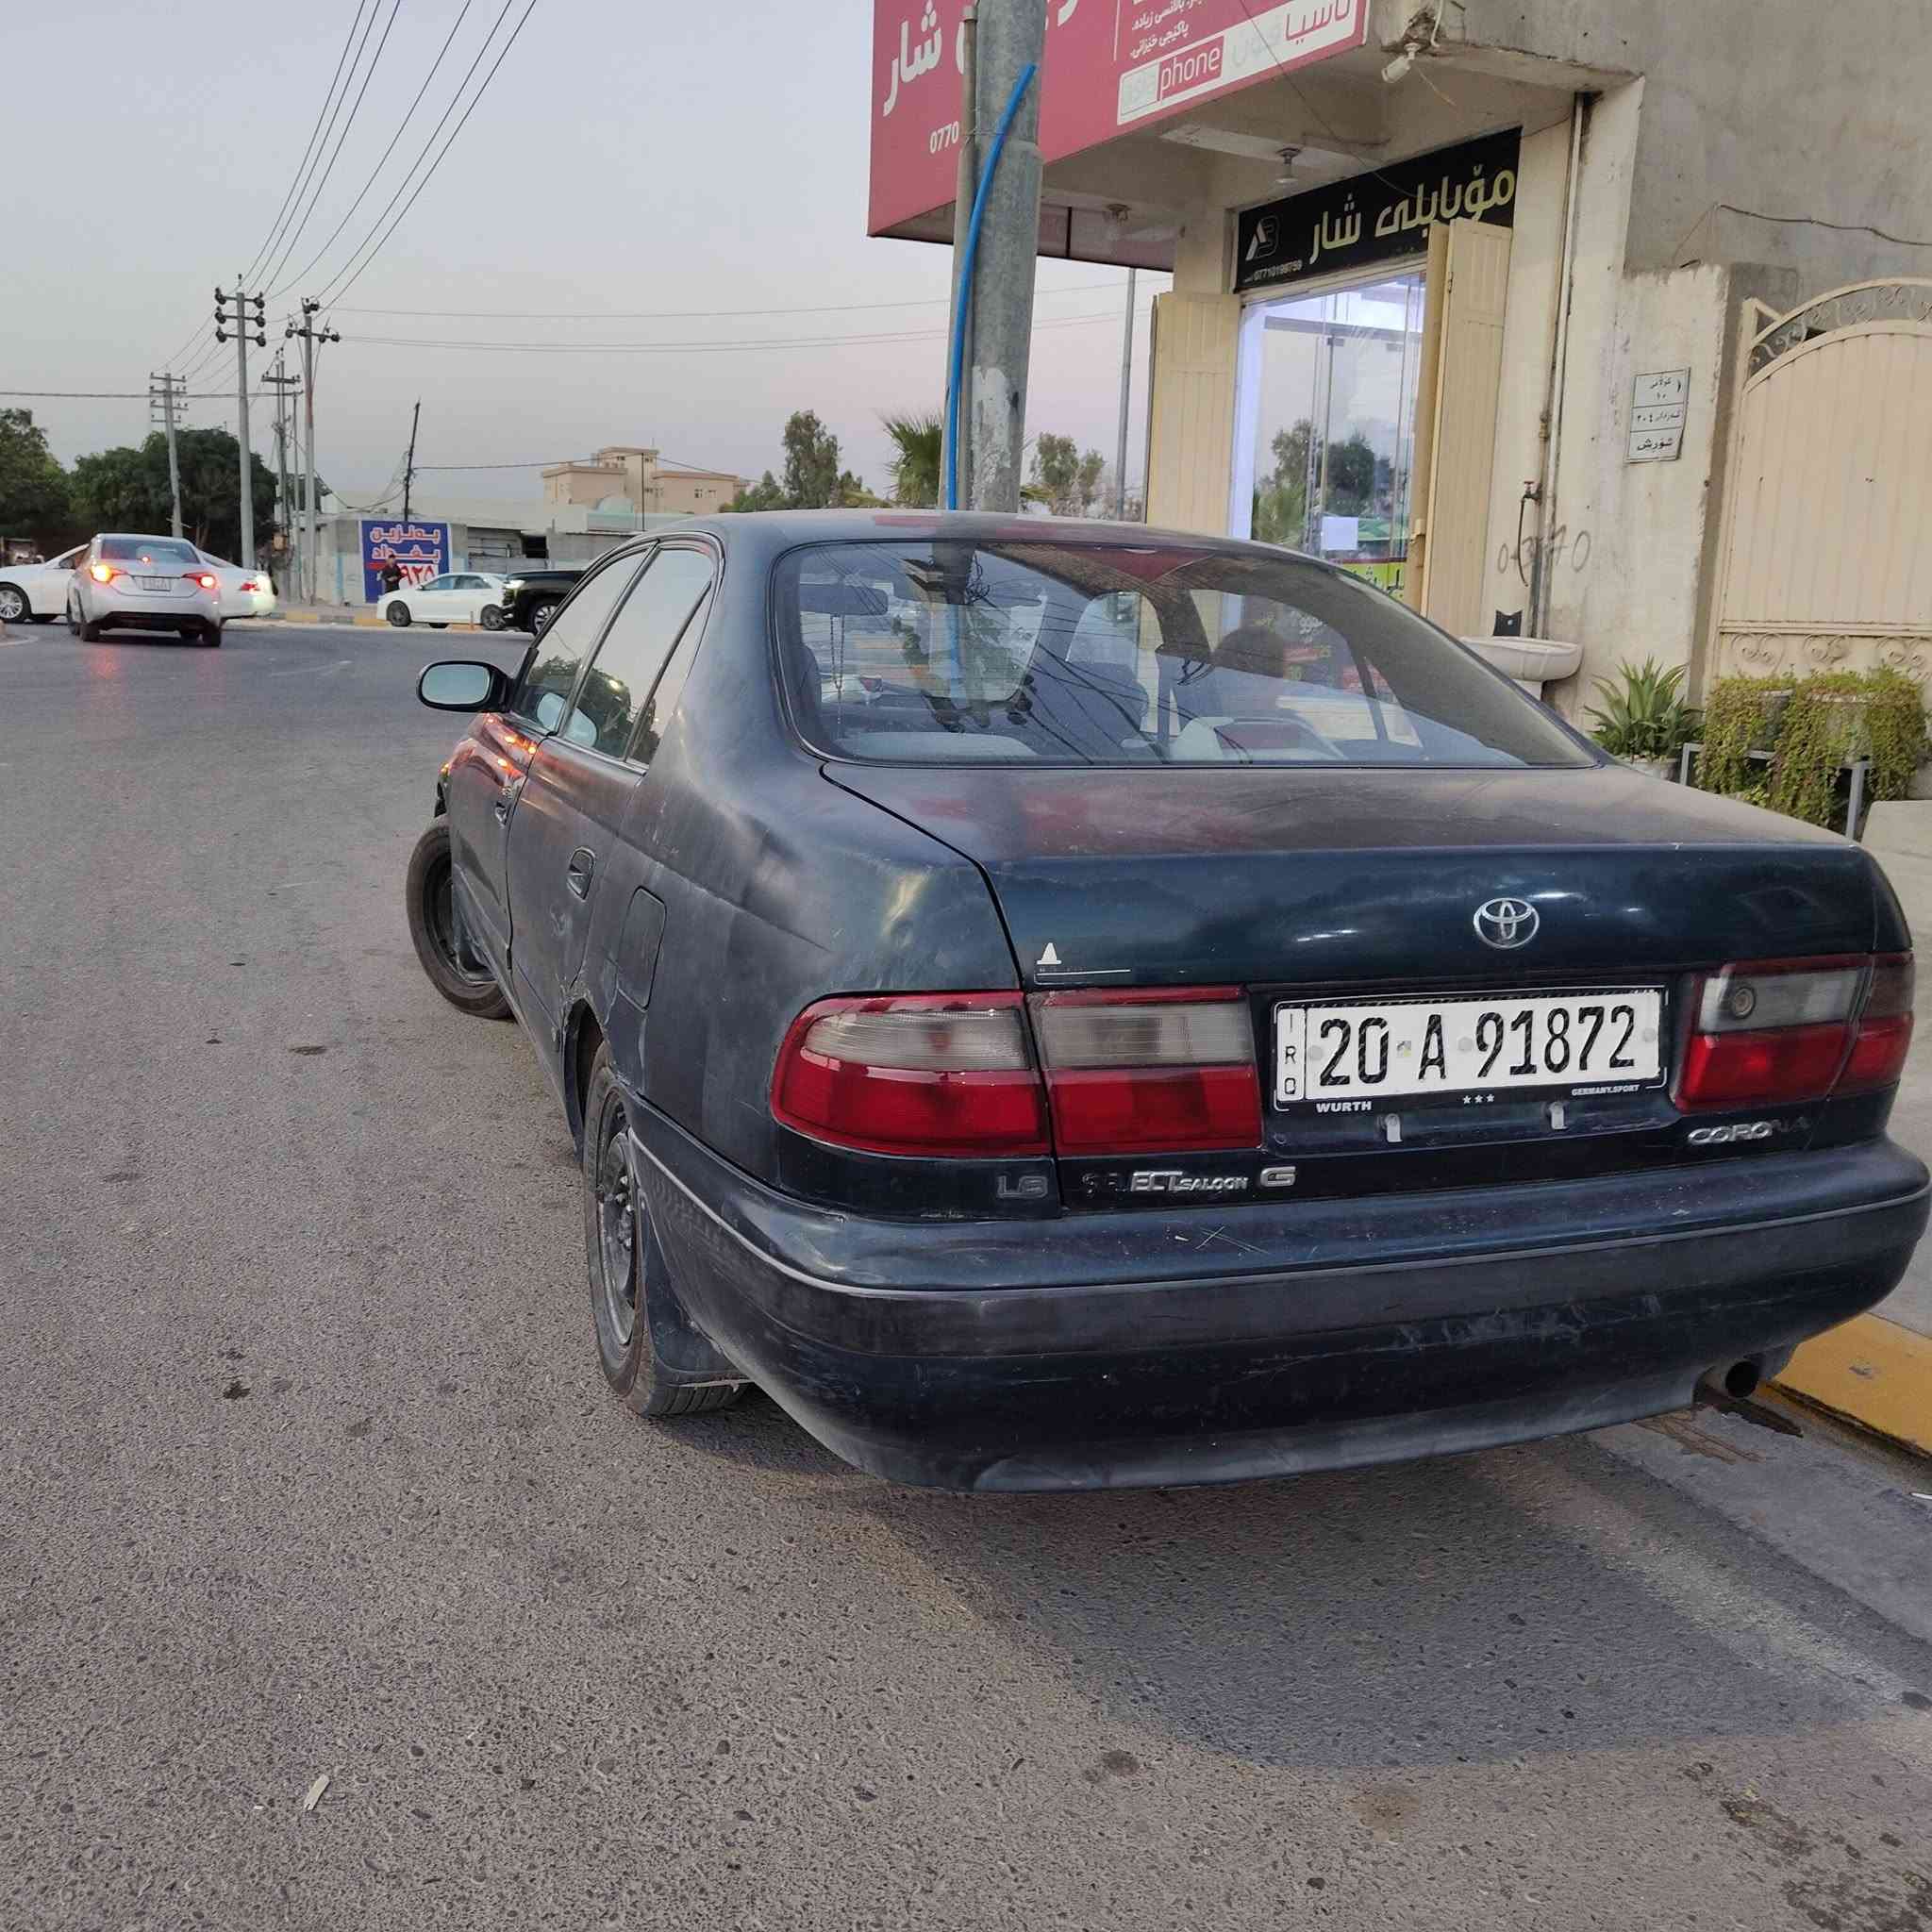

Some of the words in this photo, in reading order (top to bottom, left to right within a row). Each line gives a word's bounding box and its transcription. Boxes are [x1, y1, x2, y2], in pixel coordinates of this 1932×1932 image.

[1160, 47, 1221, 100] phone
[929, 120, 959, 154] 0770
[1309, 192, 1361, 264] شار
[1319, 1017, 1390, 1087] 20
[1418, 1014, 1447, 1081] A
[1474, 1005, 1636, 1079] 91872
[1316, 1100, 1373, 1113] WURTH
